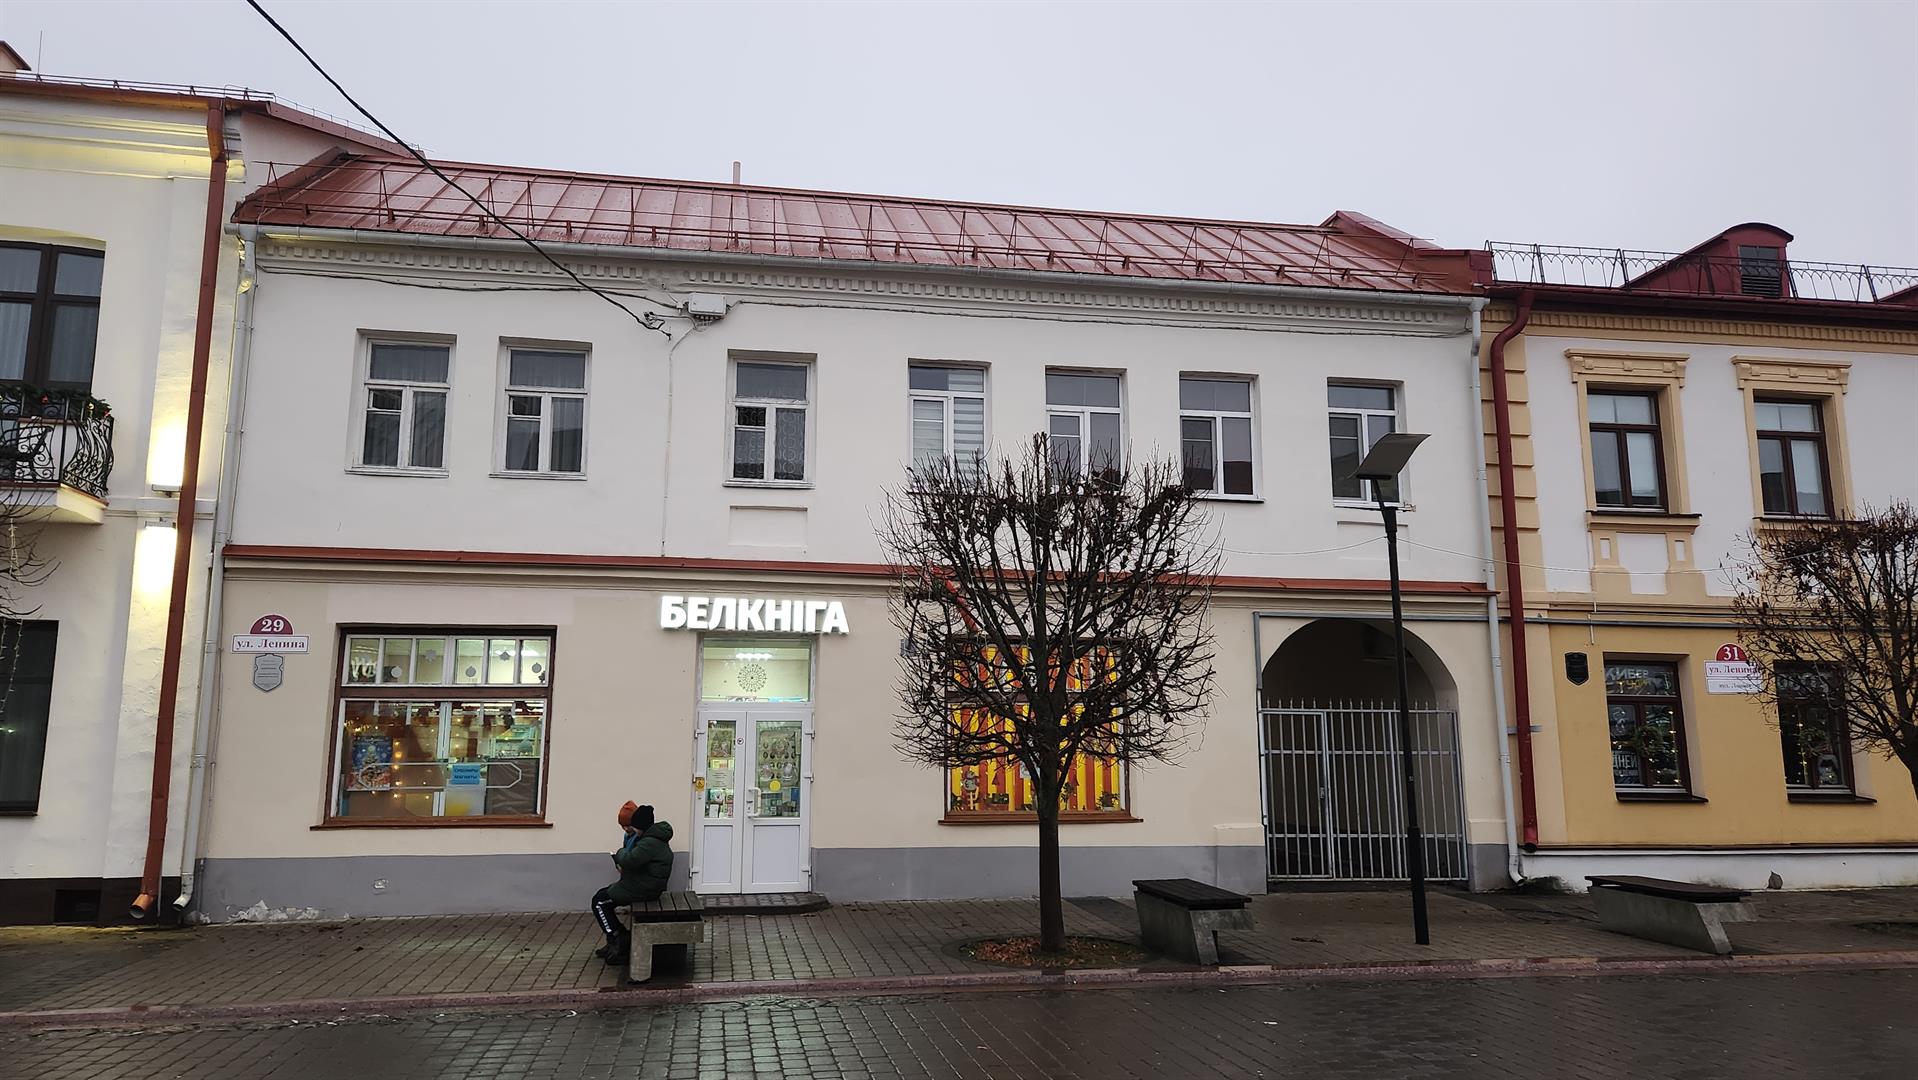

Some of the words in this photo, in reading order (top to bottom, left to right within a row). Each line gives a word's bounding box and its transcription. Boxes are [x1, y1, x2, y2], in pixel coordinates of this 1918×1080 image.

[660, 595, 850, 634] БЕЛКНІГА
[261, 618, 285, 632] 29
[236, 640, 254, 651] ул.
[258, 639, 305, 648] Ленина
[1723, 646, 1740, 660] 31
[1708, 667, 1722, 675] ул.
